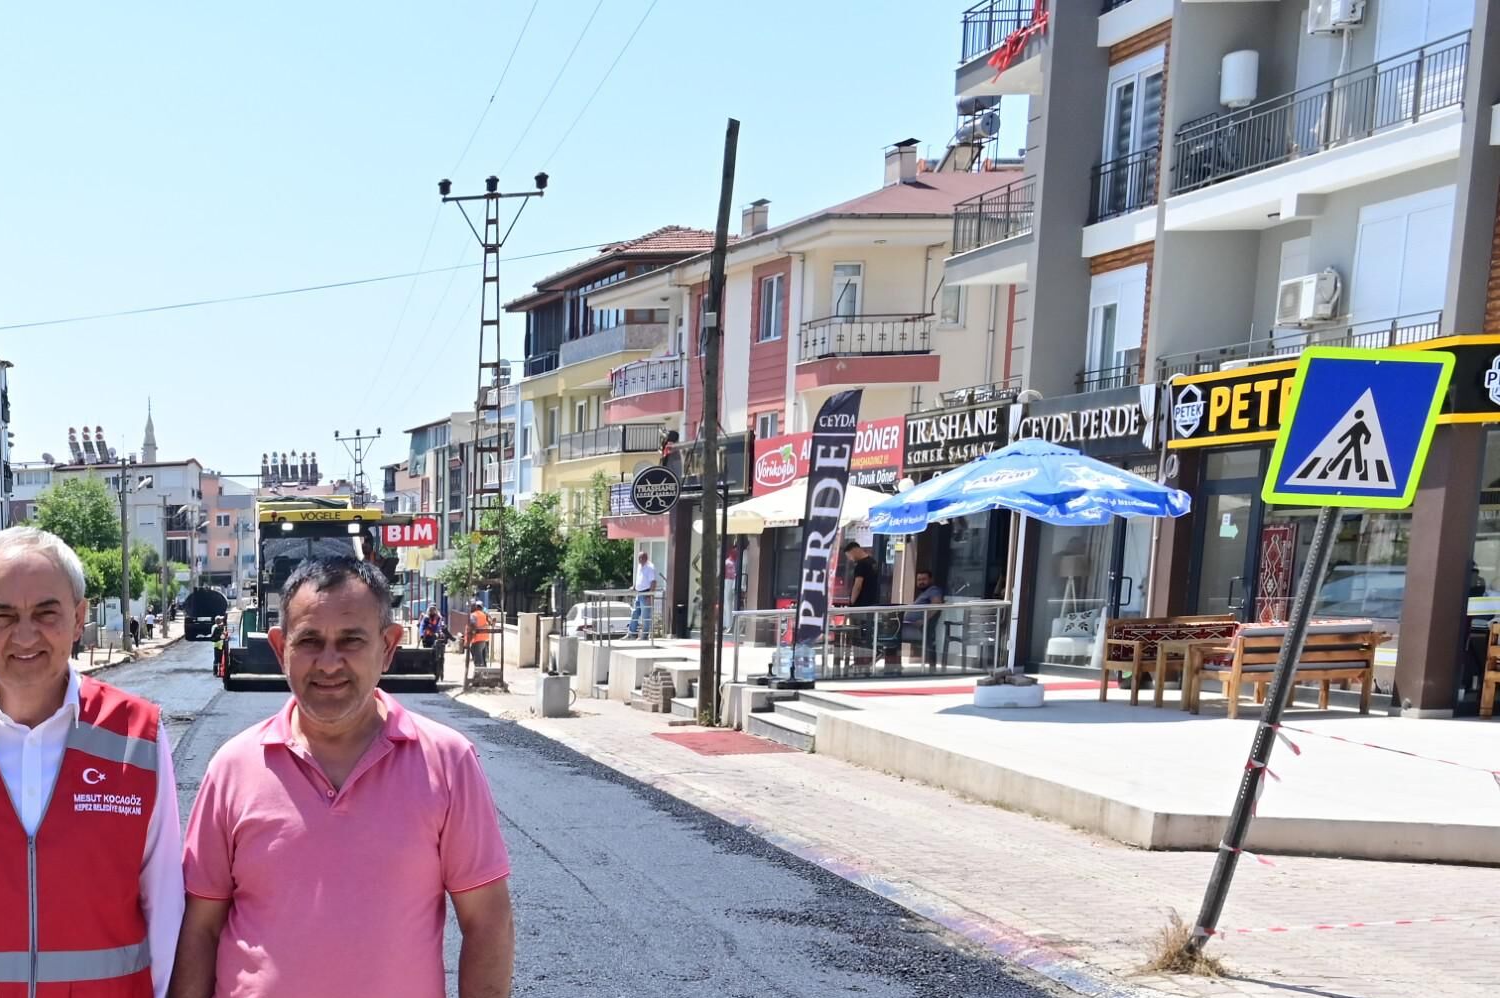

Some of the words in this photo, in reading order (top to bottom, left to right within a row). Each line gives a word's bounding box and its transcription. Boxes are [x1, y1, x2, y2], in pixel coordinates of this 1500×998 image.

[819, 413, 857, 428] CEYDA
[1175, 404, 1203, 418] PETEK
[907, 408, 998, 447] TRAŞHANE
[1018, 413, 1077, 443] CEYDA
[1078, 404, 1140, 441] PERDE
[855, 424, 900, 454] DÖNER
[858, 470, 875, 485] Tavuk
[876, 469, 897, 483] Döner
[798, 444, 851, 629] PERDE
[73, 793, 102, 803] MESUT
[103, 794, 142, 806] KOCAGÖZ
